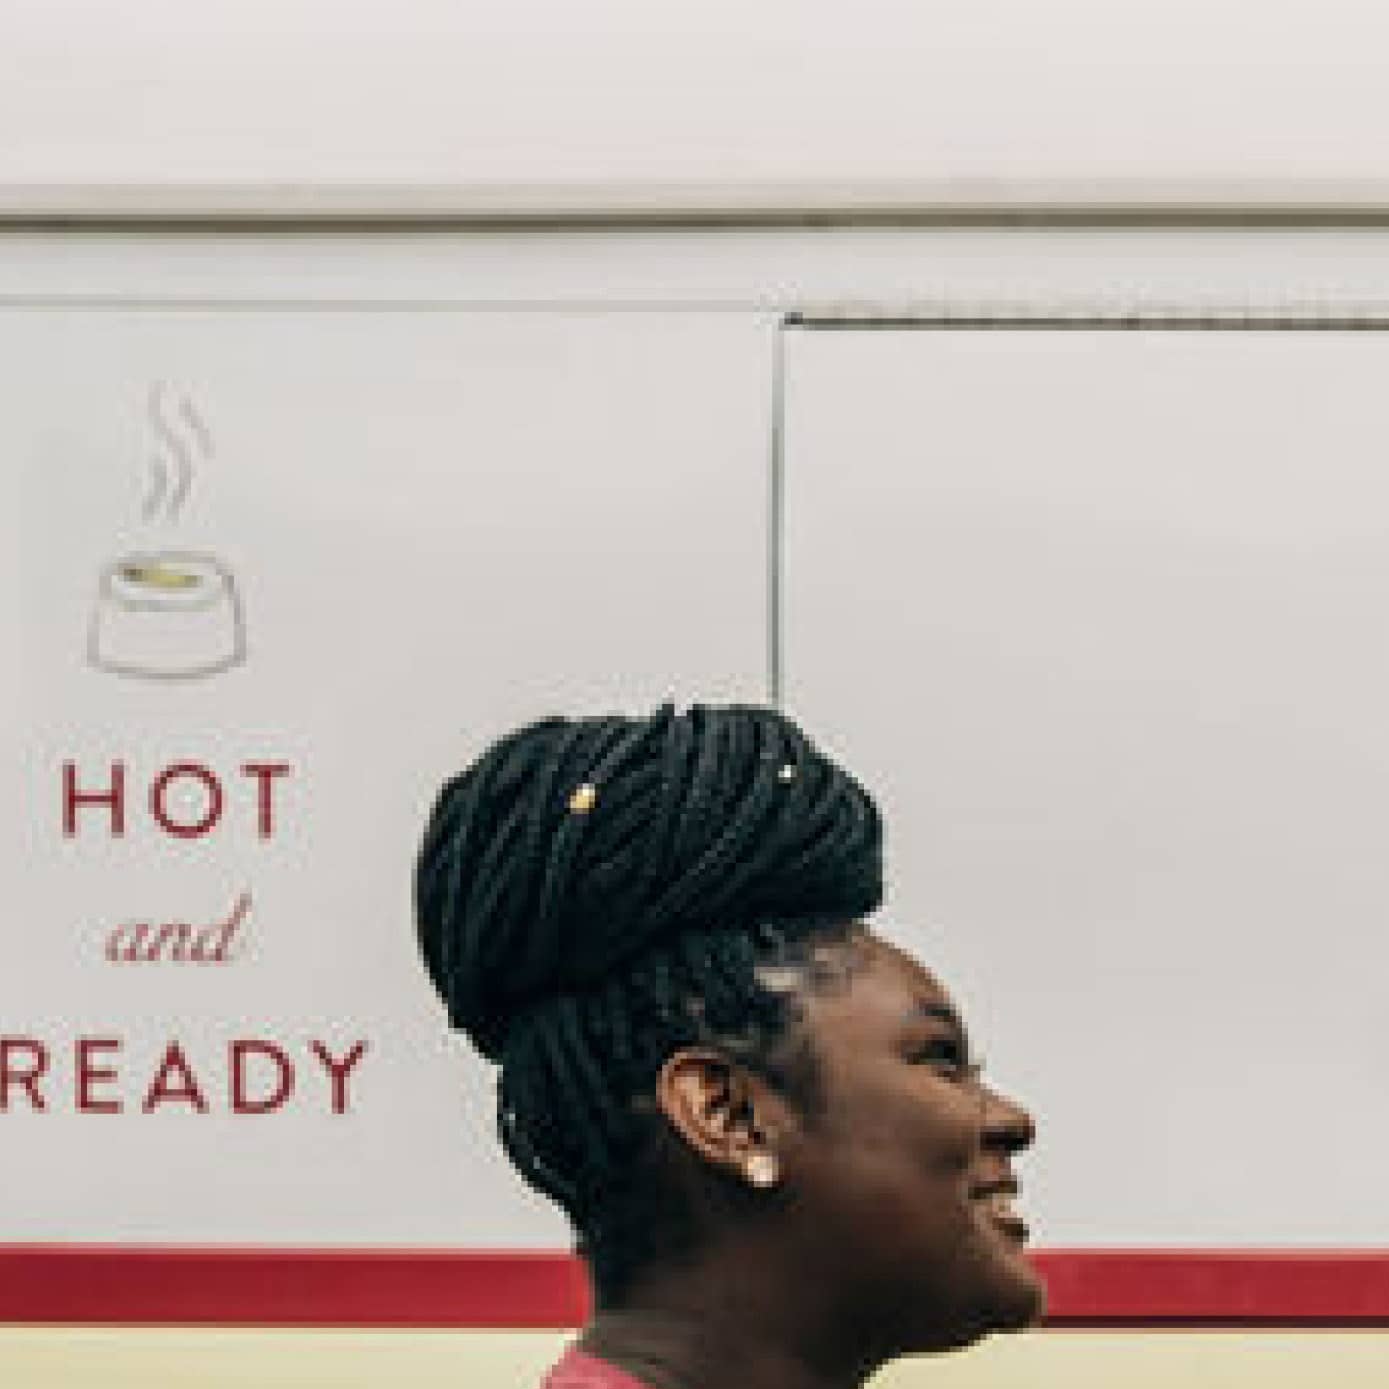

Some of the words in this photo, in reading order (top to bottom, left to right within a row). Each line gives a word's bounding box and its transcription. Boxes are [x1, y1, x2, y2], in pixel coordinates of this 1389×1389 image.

[61, 760, 291, 840] HOT
[105, 890, 253, 964] and
[0, 1038, 370, 1115] READY
